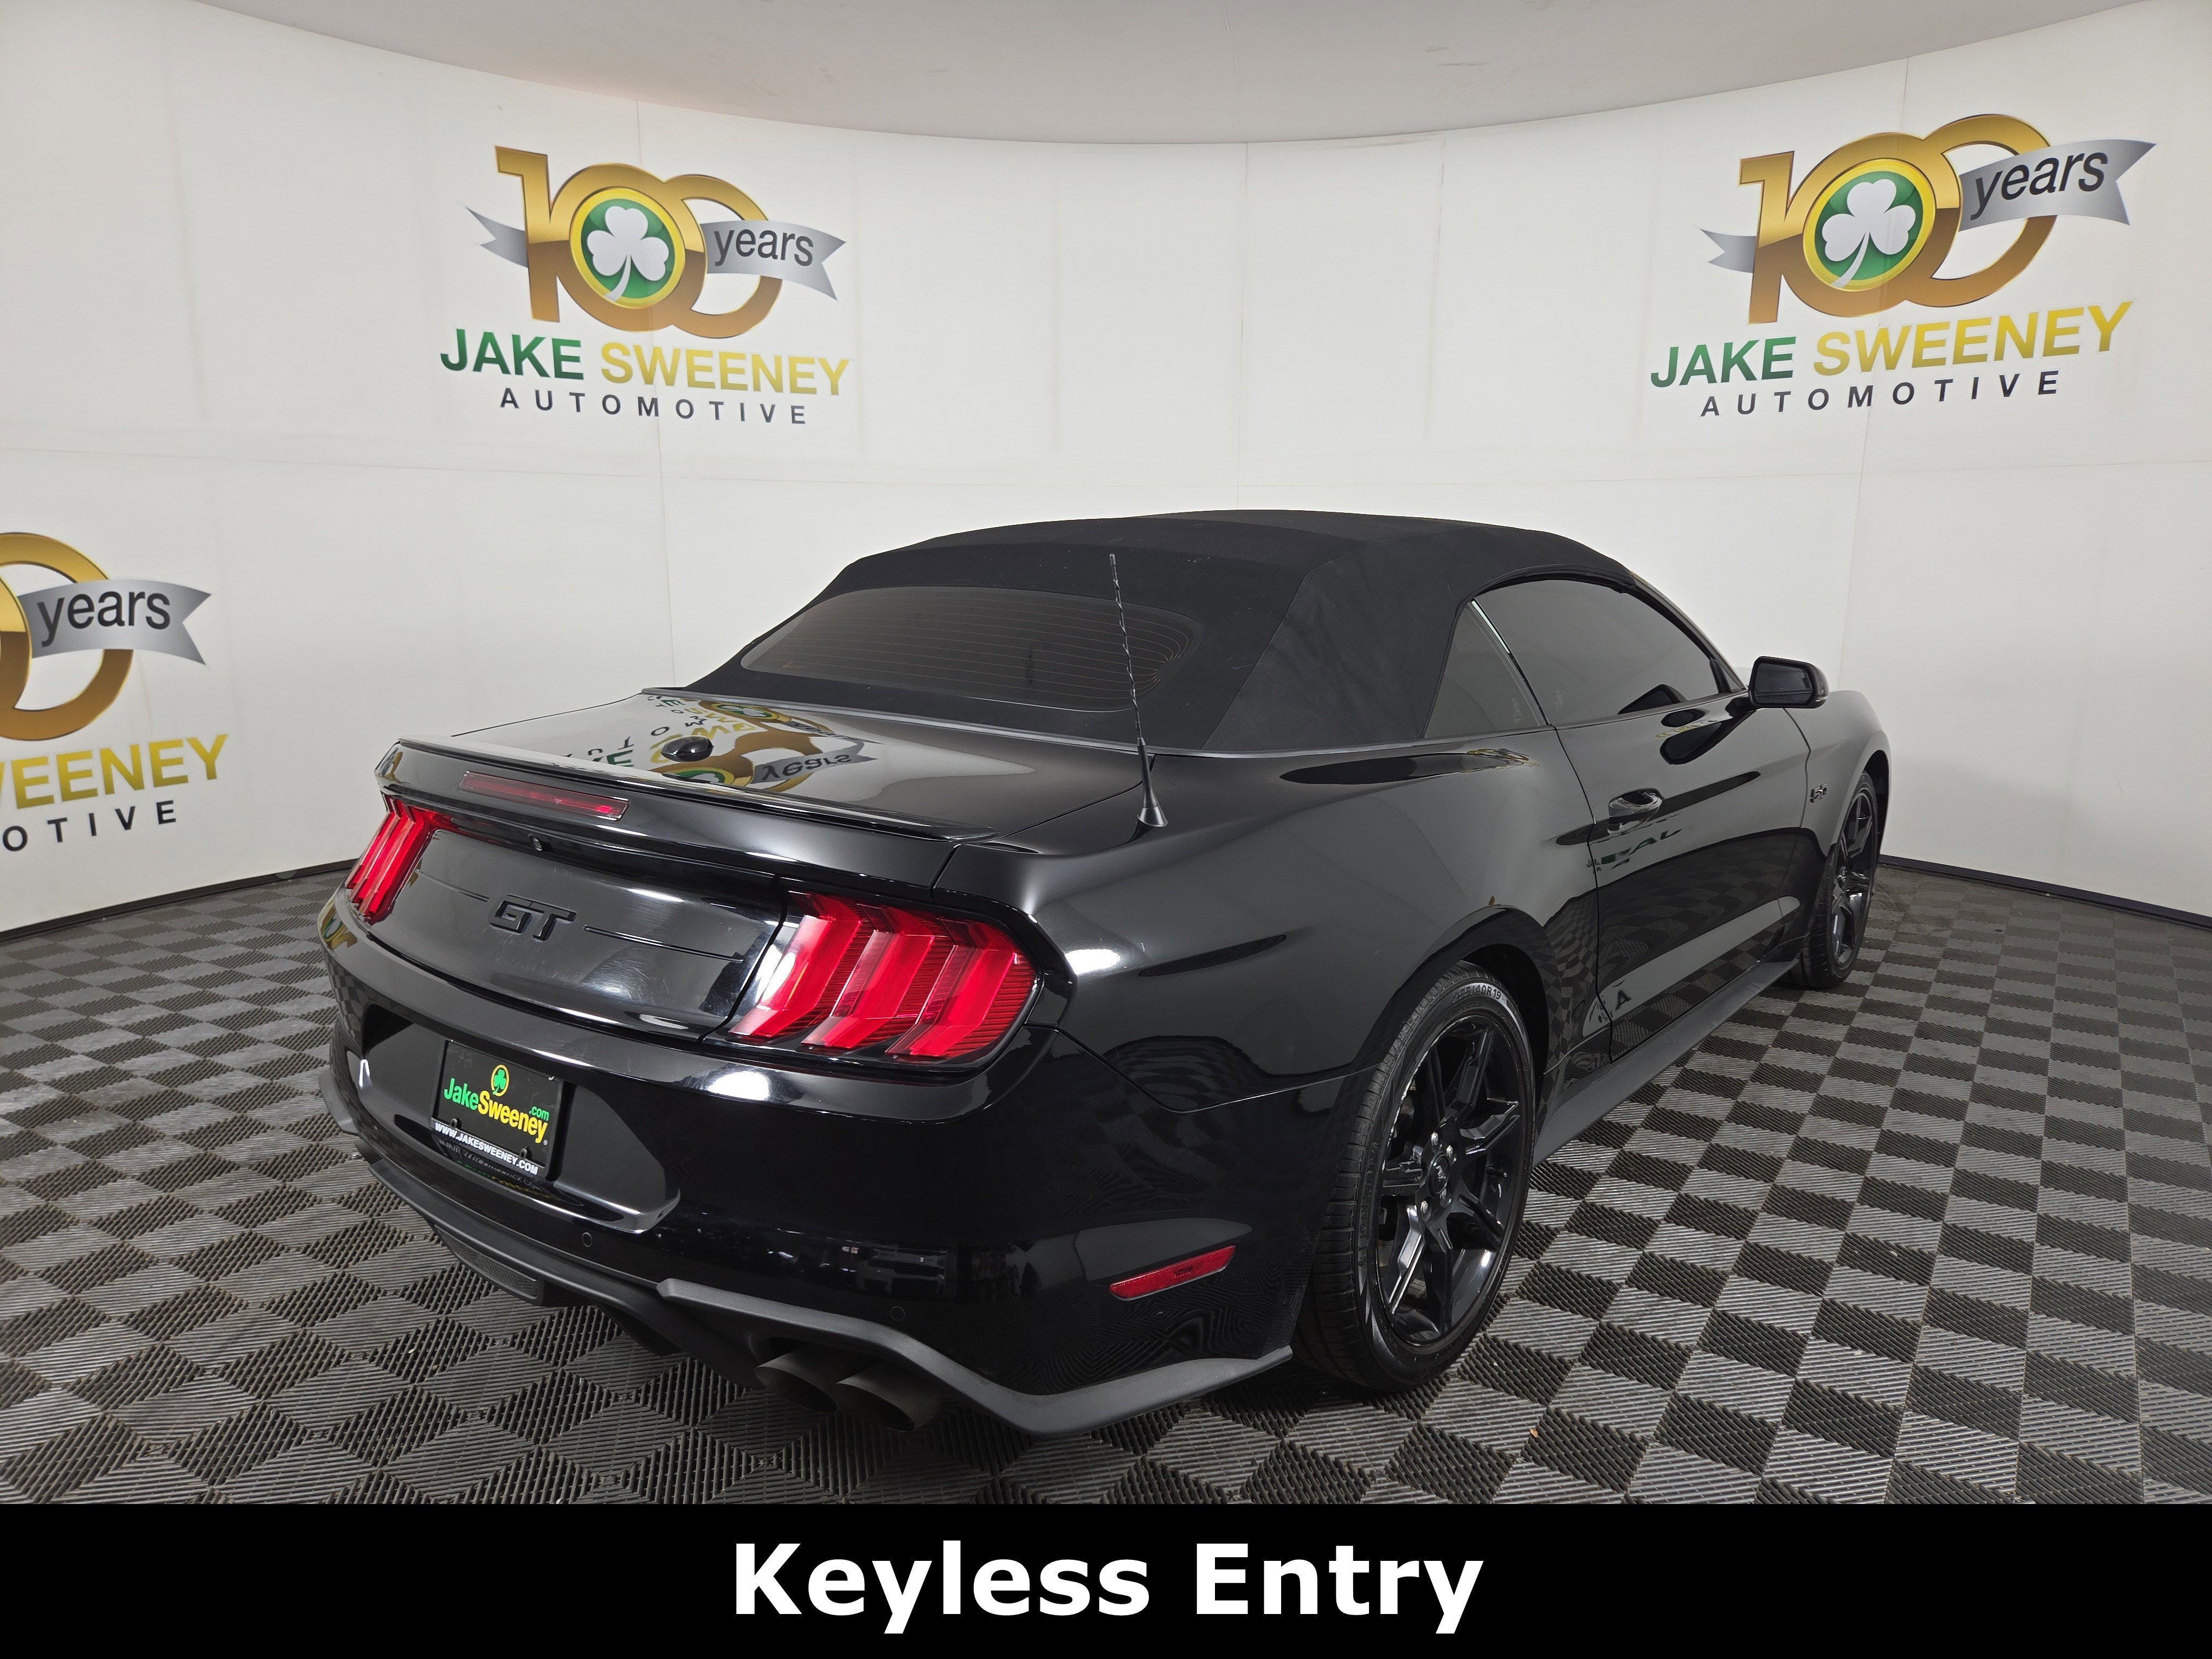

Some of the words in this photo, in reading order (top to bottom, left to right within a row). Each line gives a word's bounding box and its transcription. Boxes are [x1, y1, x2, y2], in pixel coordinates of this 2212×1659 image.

[1970, 149, 2108, 221] years
[713, 228, 814, 267] years
[440, 328, 584, 381] JAKE
[601, 342, 850, 396] SWEENEY
[1650, 336, 1797, 388] JAKE
[1814, 301, 2133, 376] SWEENEY
[500, 387, 806, 425] AUTOMOTIVE
[1700, 371, 2059, 417] AUTOMOTIVE
[37, 590, 171, 647] years
[0, 734, 229, 809] EENEY
[490, 894, 577, 942] GT
[435, 1122, 538, 1175] WWW.JAKESWEENEY.COM
